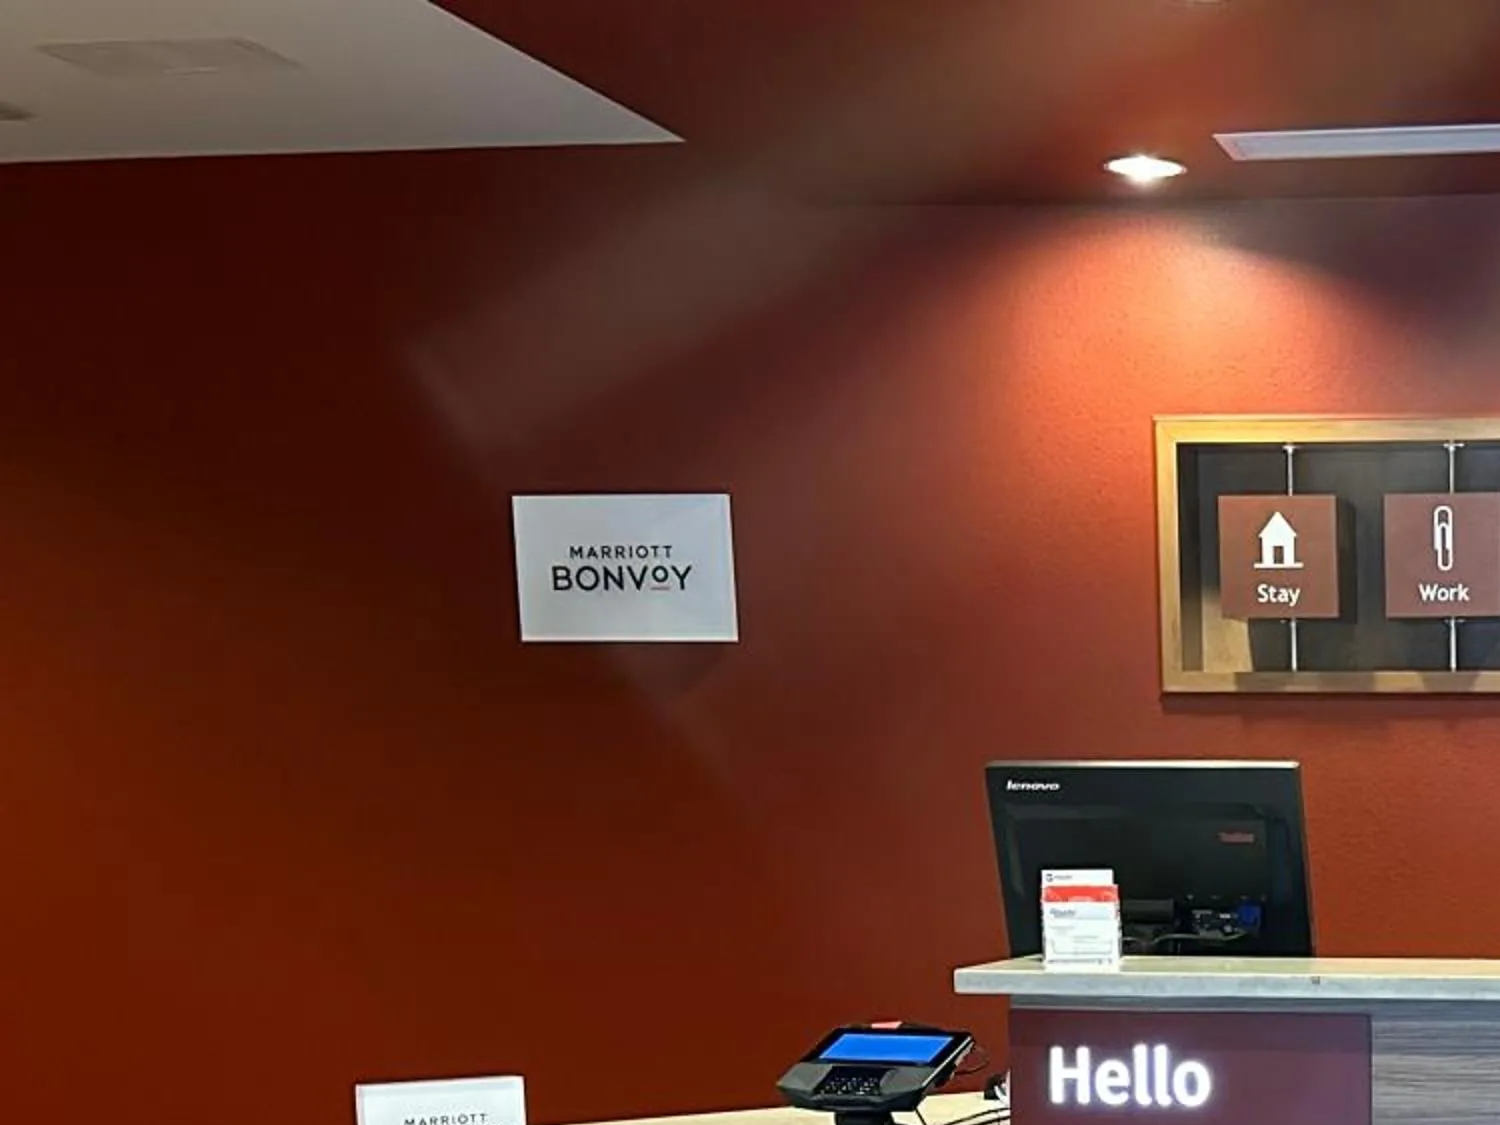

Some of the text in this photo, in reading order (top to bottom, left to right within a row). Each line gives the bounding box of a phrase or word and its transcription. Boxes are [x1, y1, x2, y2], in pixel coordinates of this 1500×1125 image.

[569, 544, 673, 559] MARRIOTT
[551, 565, 692, 591] BONVOY
[1257, 583, 1300, 606] Stay
[1419, 583, 1470, 602] Work
[1006, 780, 1061, 791] lenovo
[1050, 1043, 1212, 1107] Hello
